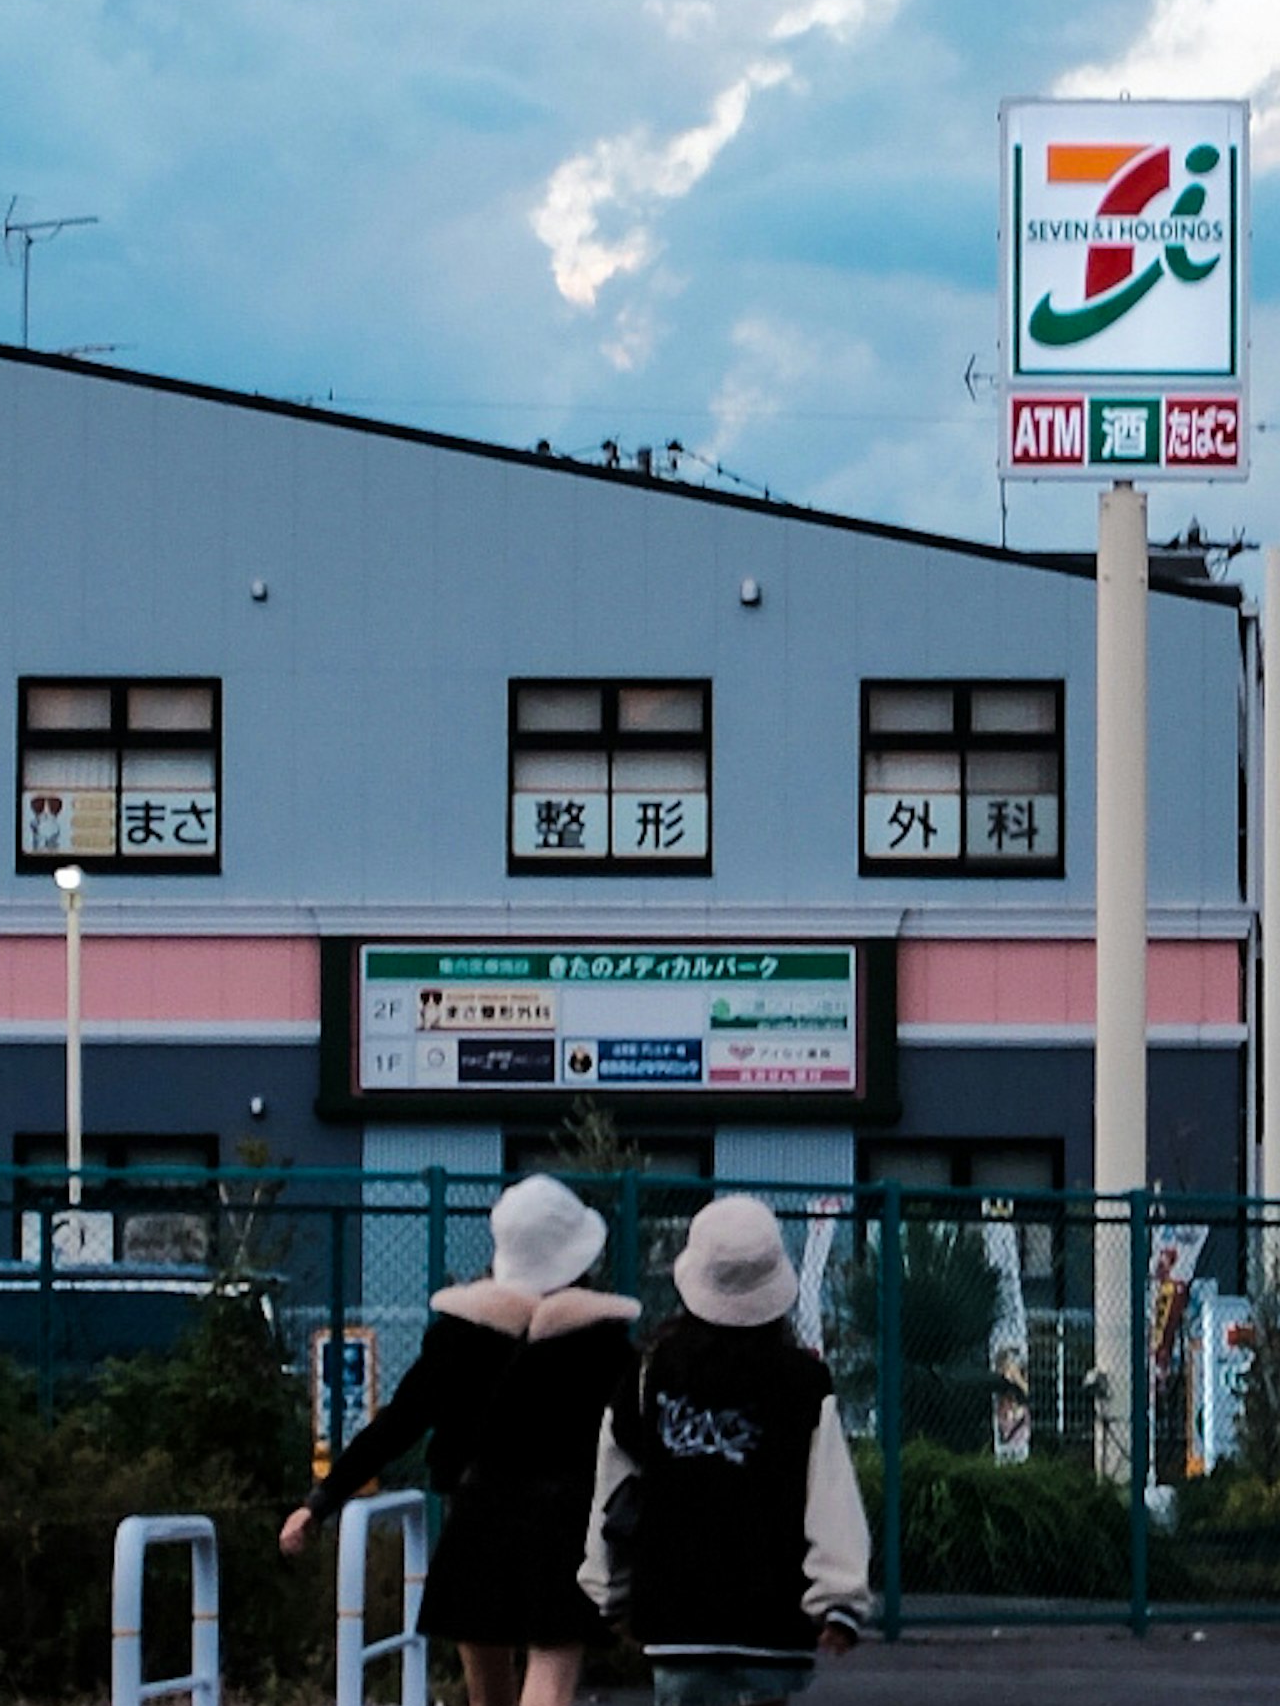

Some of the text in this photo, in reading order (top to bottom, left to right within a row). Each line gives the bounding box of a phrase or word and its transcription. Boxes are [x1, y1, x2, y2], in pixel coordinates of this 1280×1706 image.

[1120, 219, 1223, 242] HOLDINGS
[1014, 406, 1082, 458] ATM
[1101, 406, 1149, 459] 酒
[1167, 406, 1237, 459] たばこ
[125, 800, 213, 844] まさ
[888, 800, 1038, 850] 外科
[548, 955, 779, 980] きたのメディカルパーク
[374, 1000, 402, 1020] 2F
[375, 1053, 402, 1072] 1F
